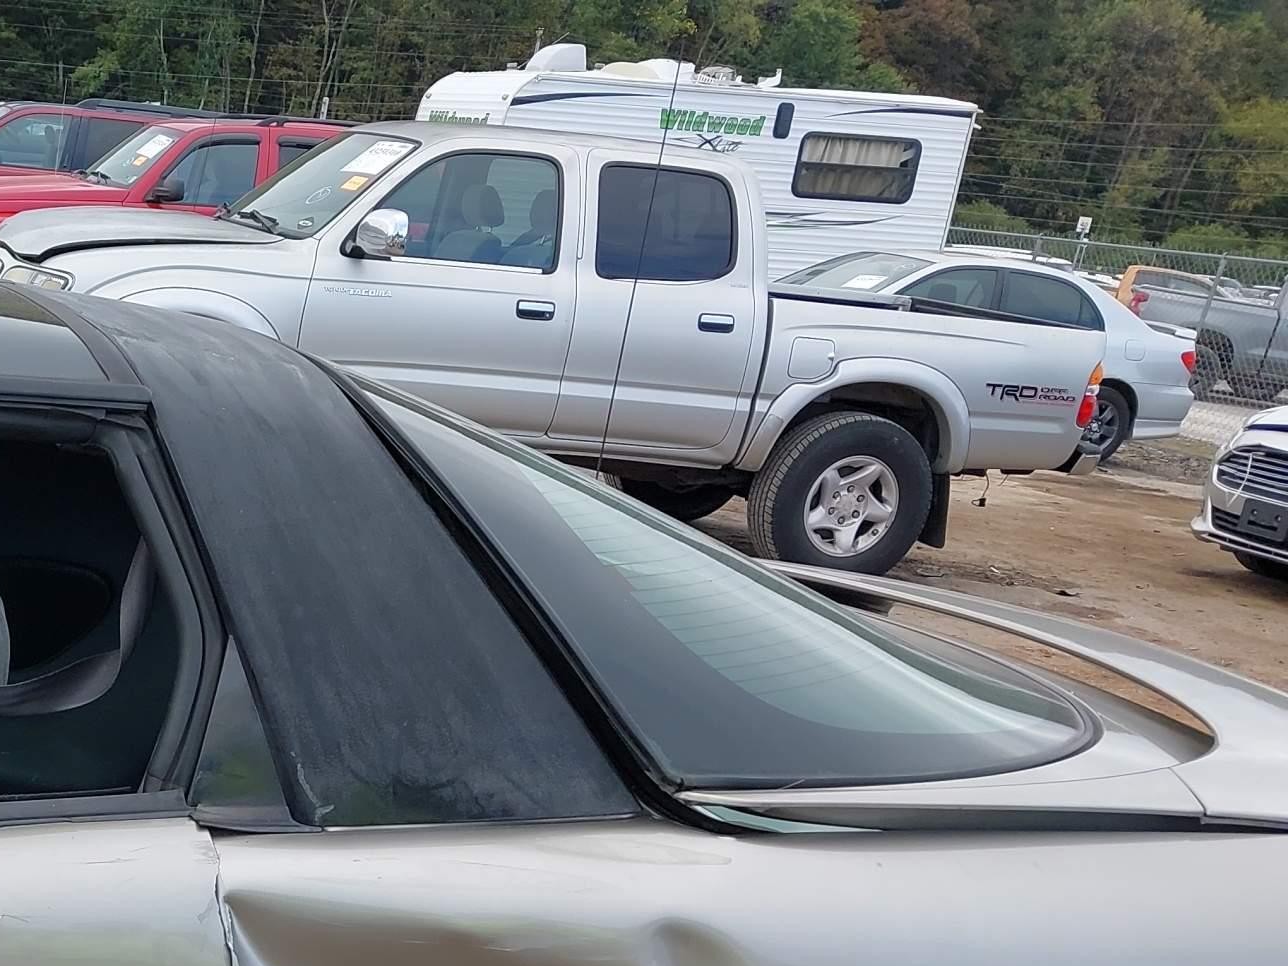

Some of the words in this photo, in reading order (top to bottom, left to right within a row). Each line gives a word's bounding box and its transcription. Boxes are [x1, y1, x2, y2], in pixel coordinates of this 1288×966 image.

[658, 108, 766, 137] Wildwood
[986, 383, 1038, 401] TRD
[1038, 394, 1076, 402] ROAD
